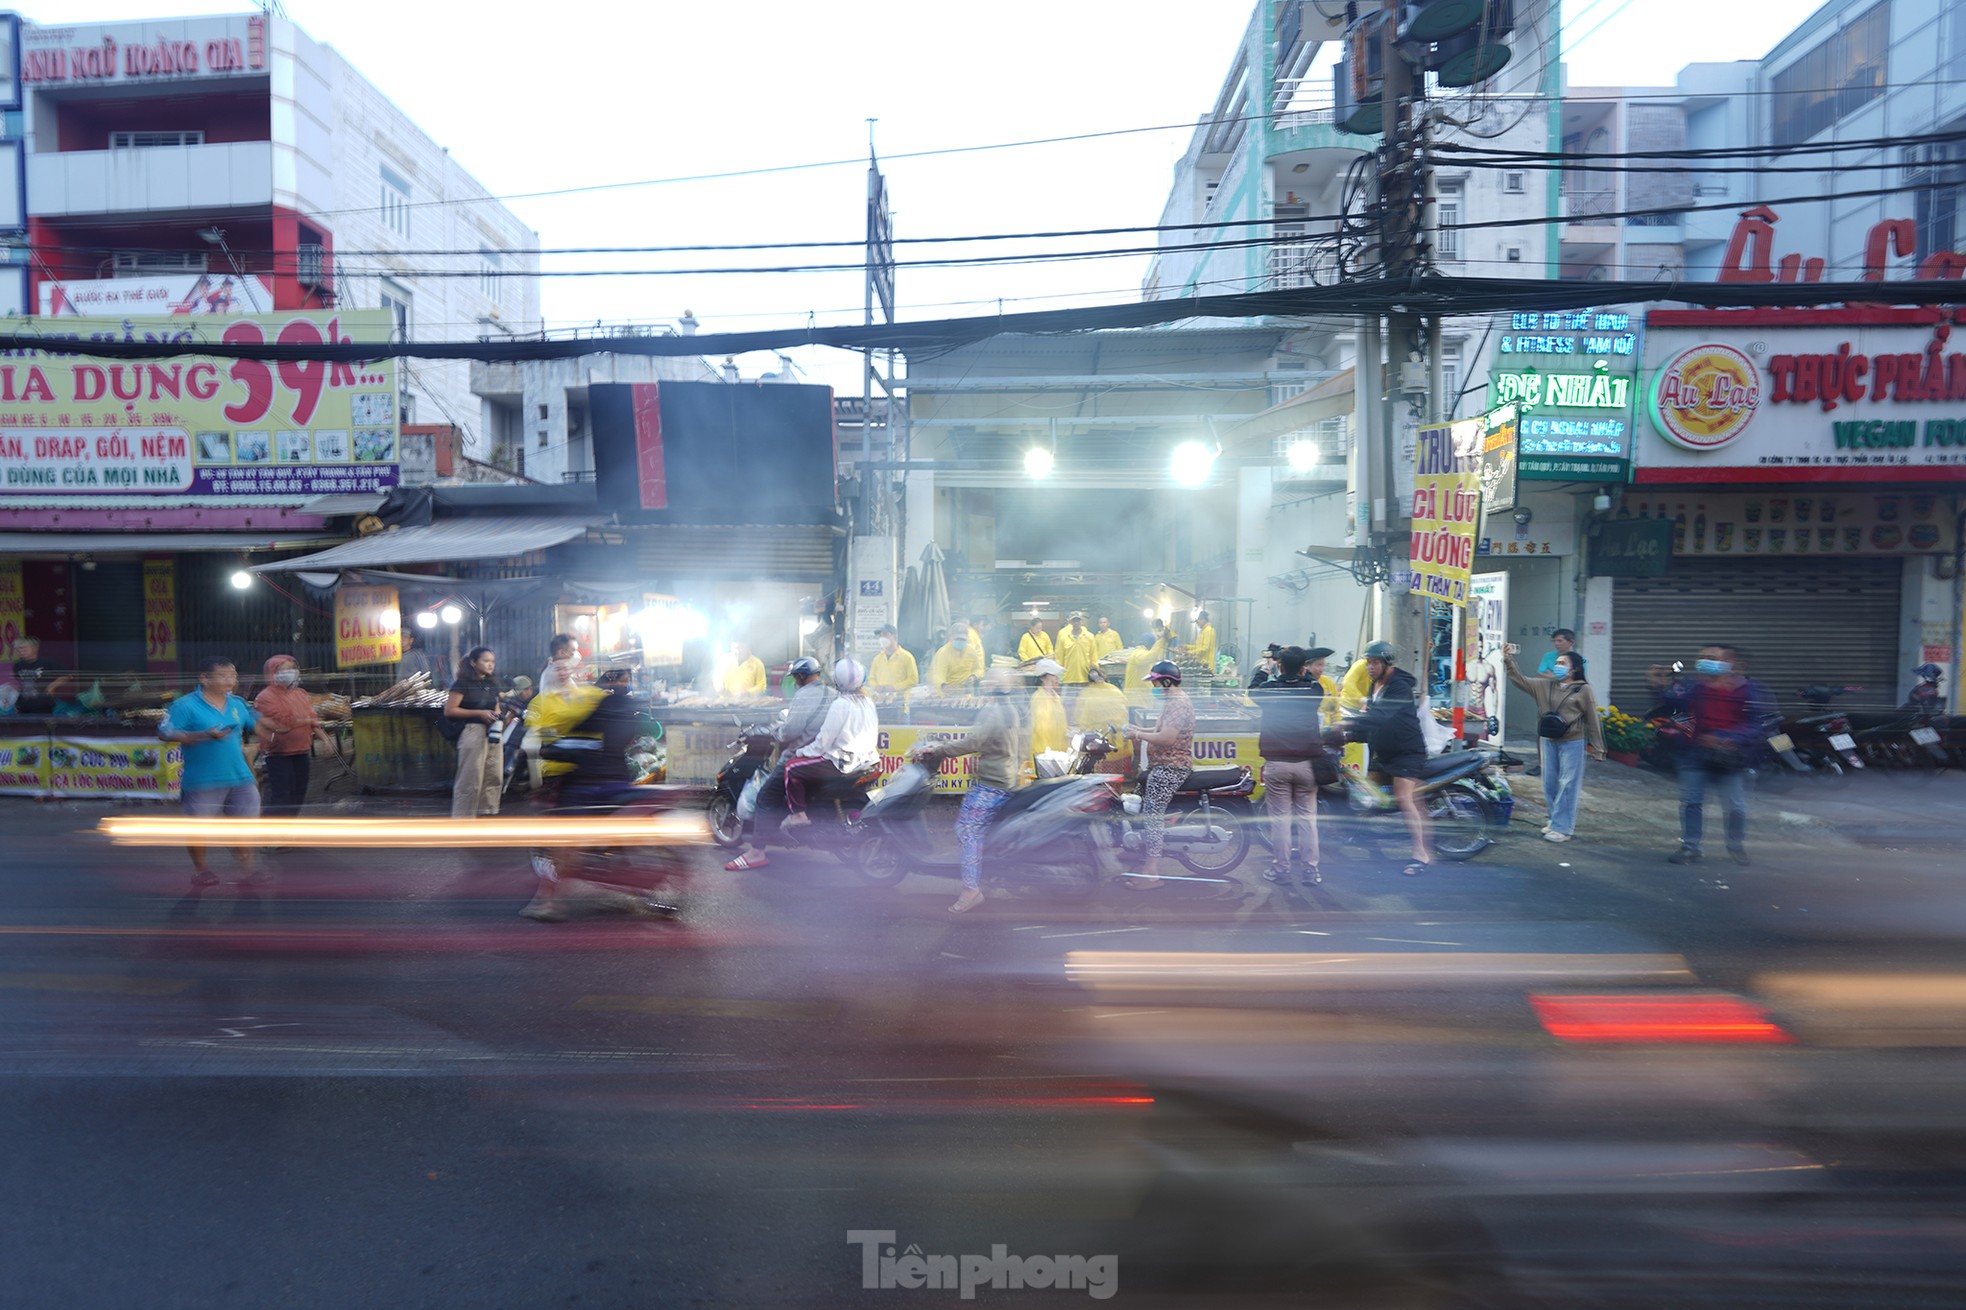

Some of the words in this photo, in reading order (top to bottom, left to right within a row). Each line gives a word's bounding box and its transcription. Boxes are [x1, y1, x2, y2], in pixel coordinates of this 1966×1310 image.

[206, 37, 244, 71] GIA
[73, 363, 220, 412] DỤNG
[1769, 342, 1869, 412] THỰC
[1706, 375, 1761, 414] Lạc
[35, 436, 91, 461] DRAP,
[141, 431, 187, 465] NỆM
[1833, 421, 1917, 449] VEGAN
[7, 462, 56, 485] DÙNG
[62, 459, 97, 485] CỦA
[104, 466, 138, 490] MỌI
[143, 462, 181, 485] NHÀ
[1412, 482, 1438, 522] CÁ
[1443, 482, 1478, 524] LÓC
[862, 581, 881, 592] 44
